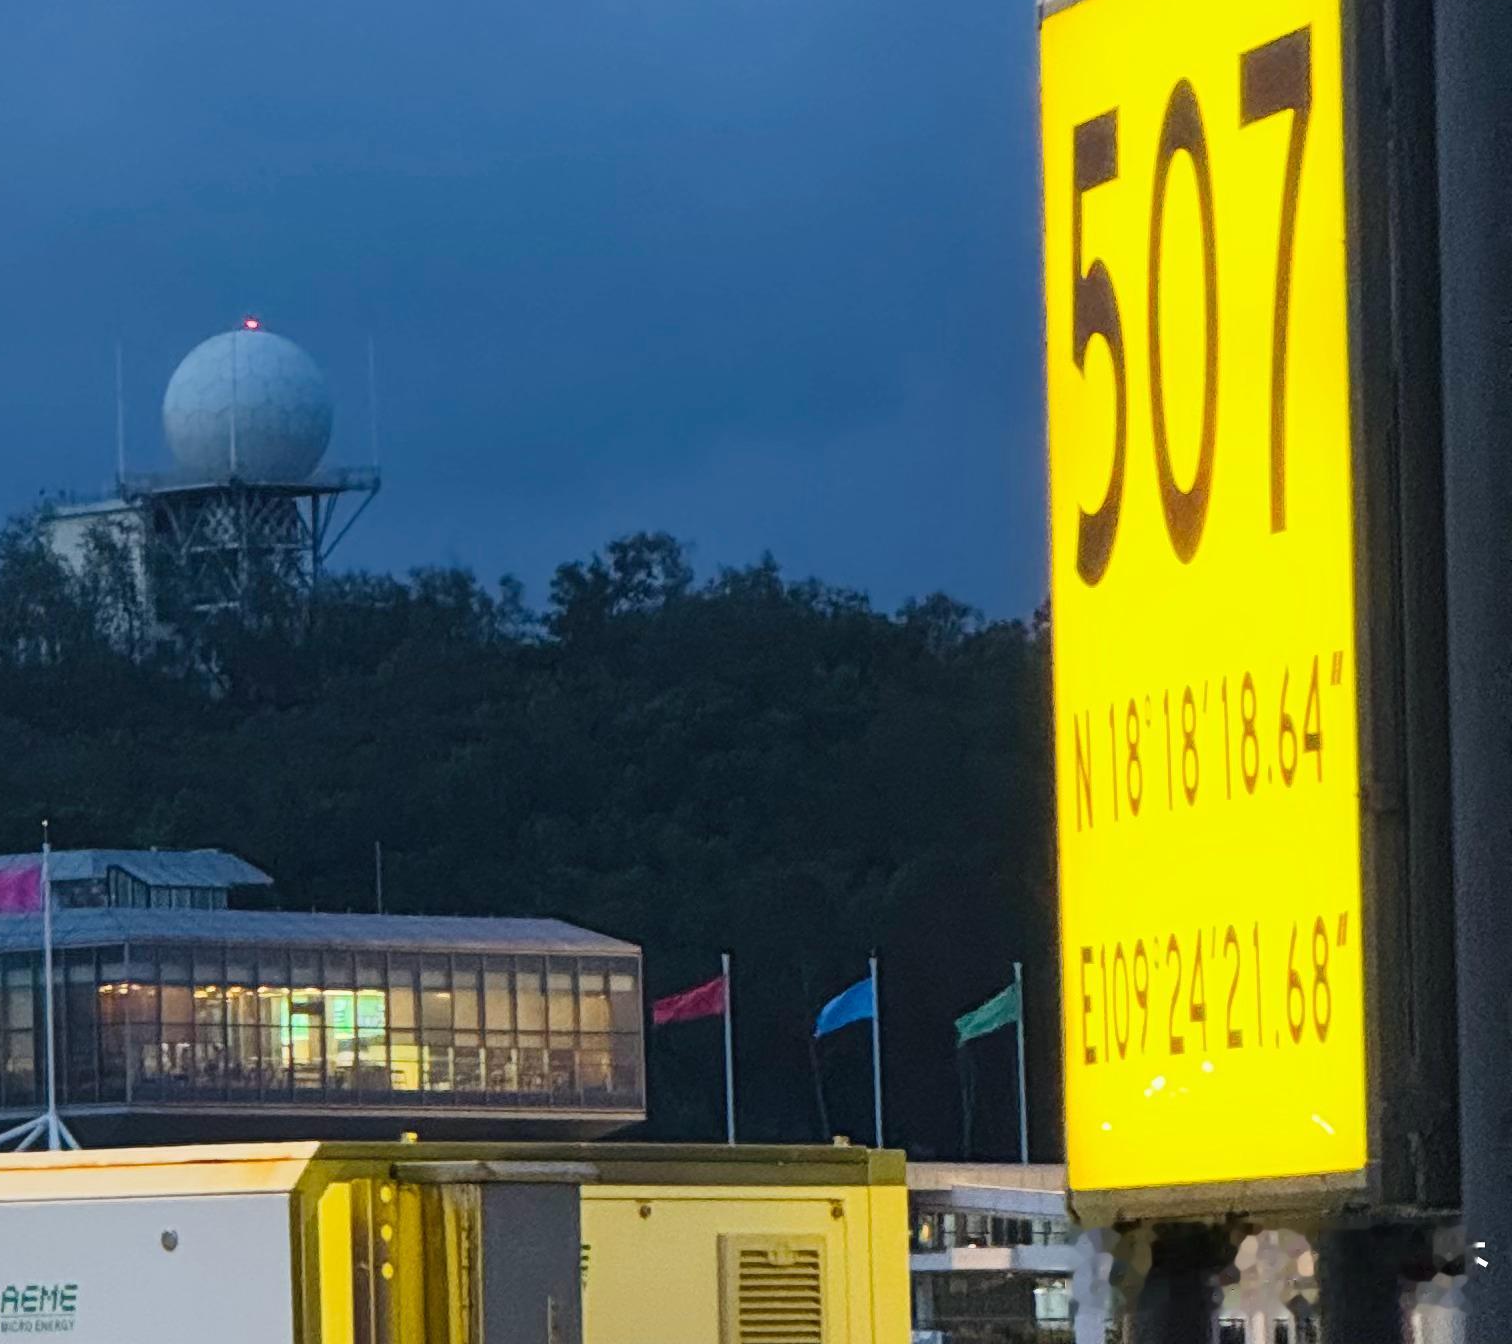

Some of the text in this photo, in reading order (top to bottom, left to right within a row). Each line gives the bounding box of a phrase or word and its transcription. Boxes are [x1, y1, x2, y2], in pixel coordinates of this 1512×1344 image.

[1072, 23, 1312, 589] 507
[0, 1284, 79, 1313] AEME
[0, 1319, 76, 1333] MICRO ENERGY
